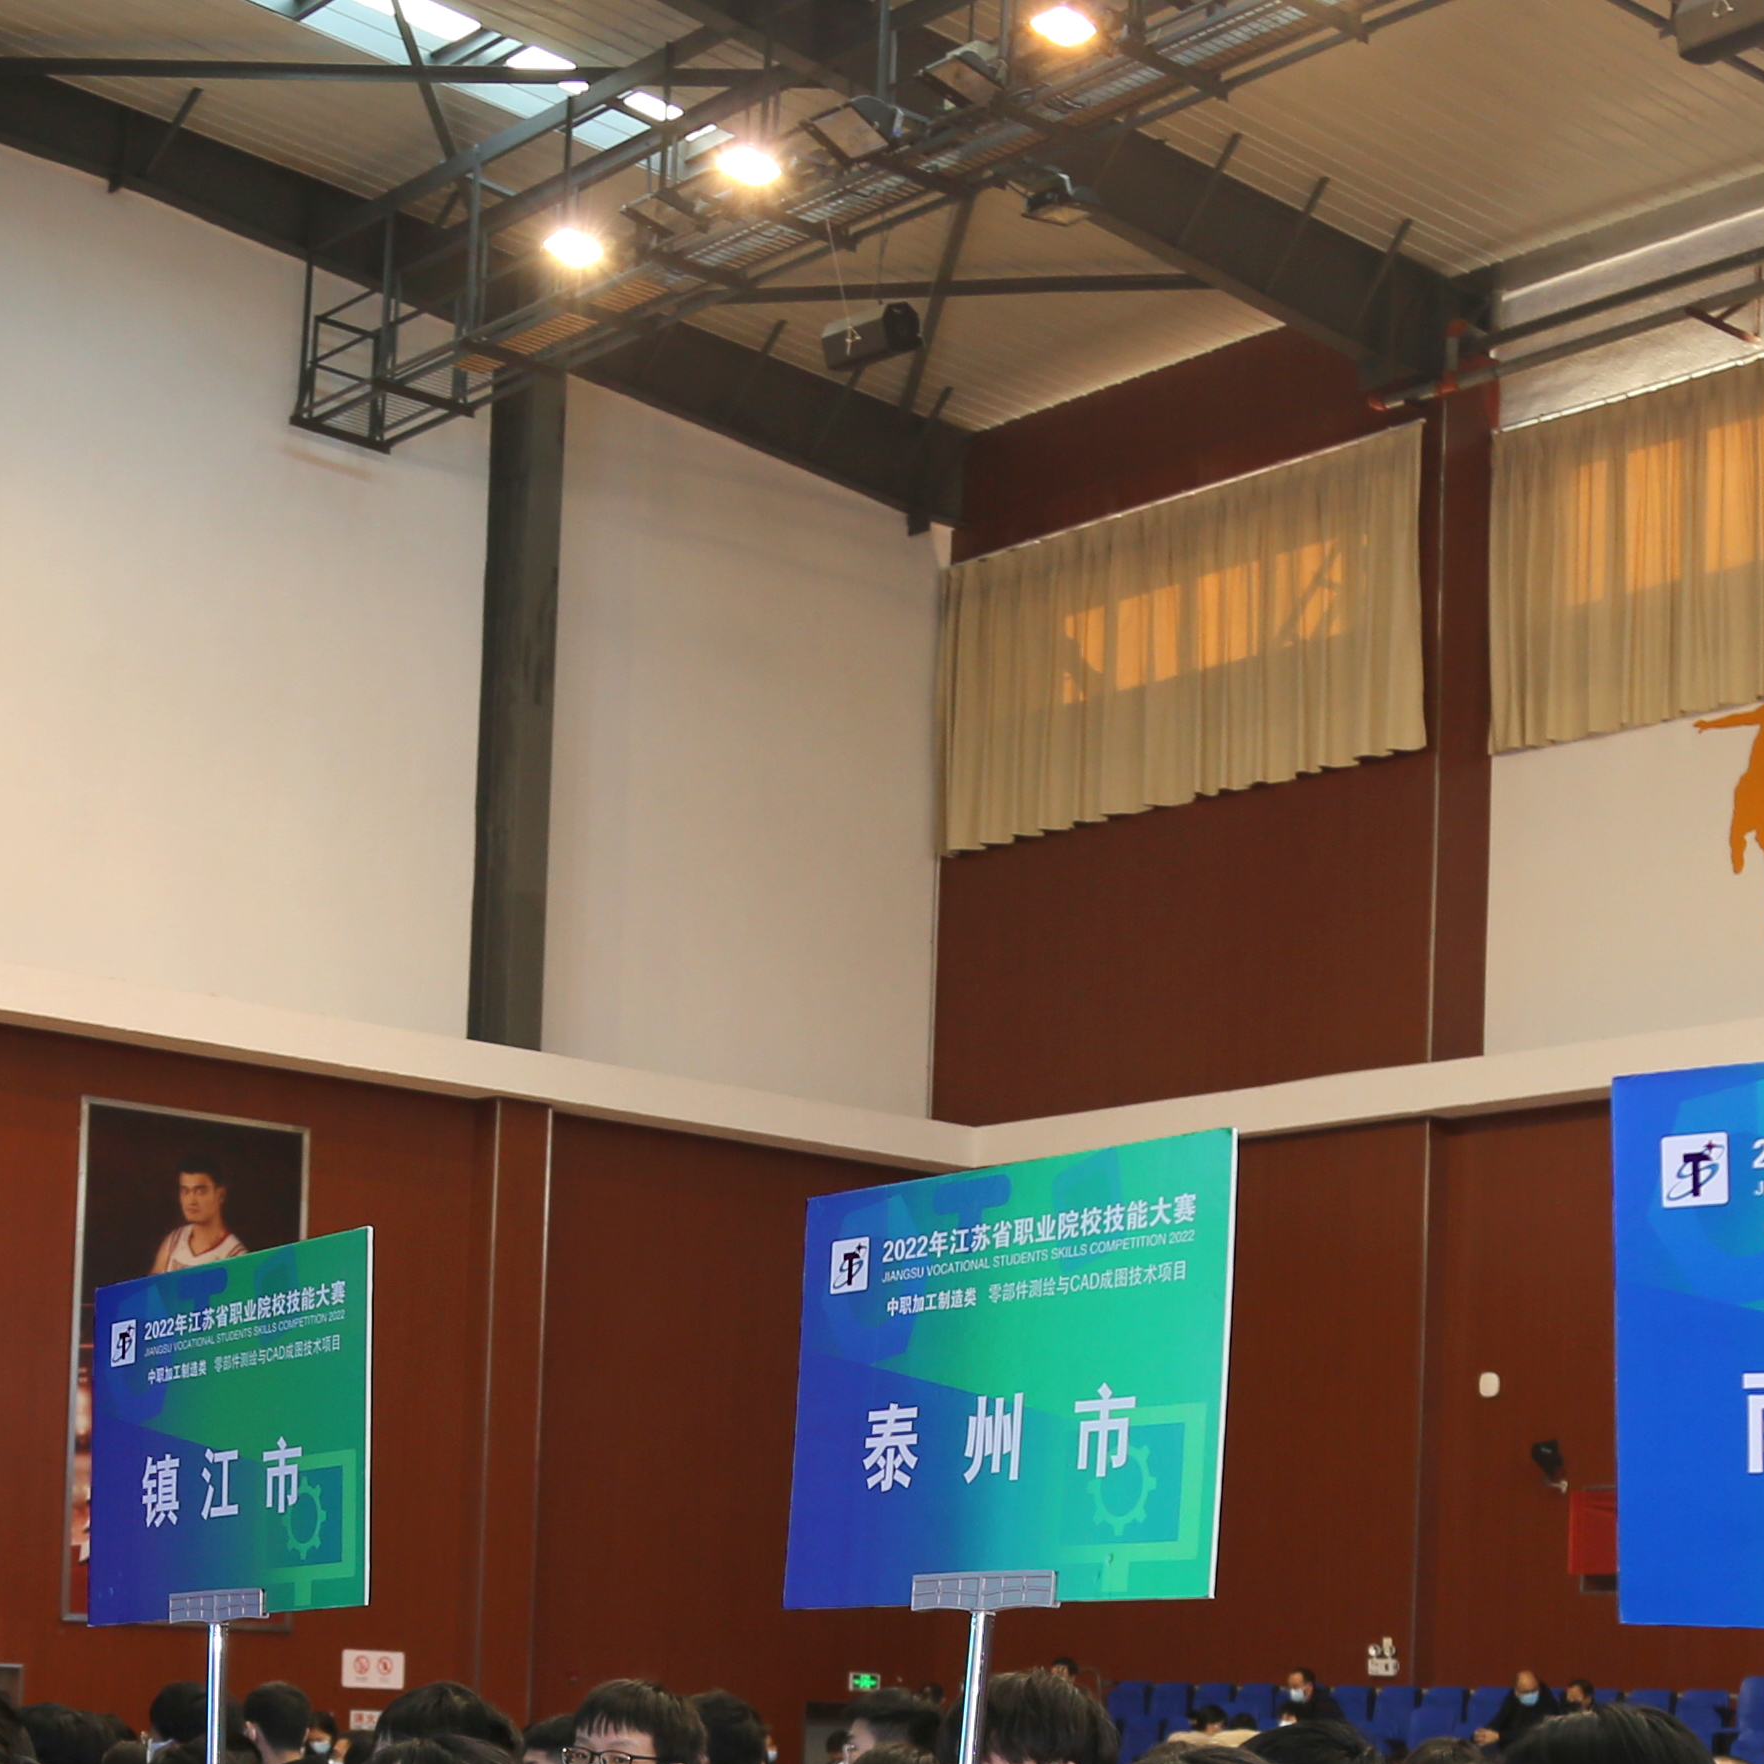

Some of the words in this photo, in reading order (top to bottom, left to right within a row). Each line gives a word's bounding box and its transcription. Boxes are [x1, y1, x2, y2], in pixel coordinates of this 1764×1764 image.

[881, 1266, 924, 1283] JIANGSU
[926, 1258, 991, 1276] VOCATIONAL
[992, 1249, 1048, 1268] STUDENTS
[1051, 1244, 1087, 1261] SKILLS
[1089, 1233, 1167, 1255] COMPETITION
[1168, 1229, 1195, 1244] 2022
[882, 1192, 1197, 1263] 2022年江苏省职业院校技能大赛
[144, 1280, 346, 1341] 2022年江苏省职业院校技能大赛
[886, 1287, 977, 1317] 中职加工制造类
[988, 1260, 1187, 1304] 零部件测绘与CAD成图技术项目
[861, 1382, 1136, 1493] 泰州市
[141, 1435, 303, 1528] 镇江市
